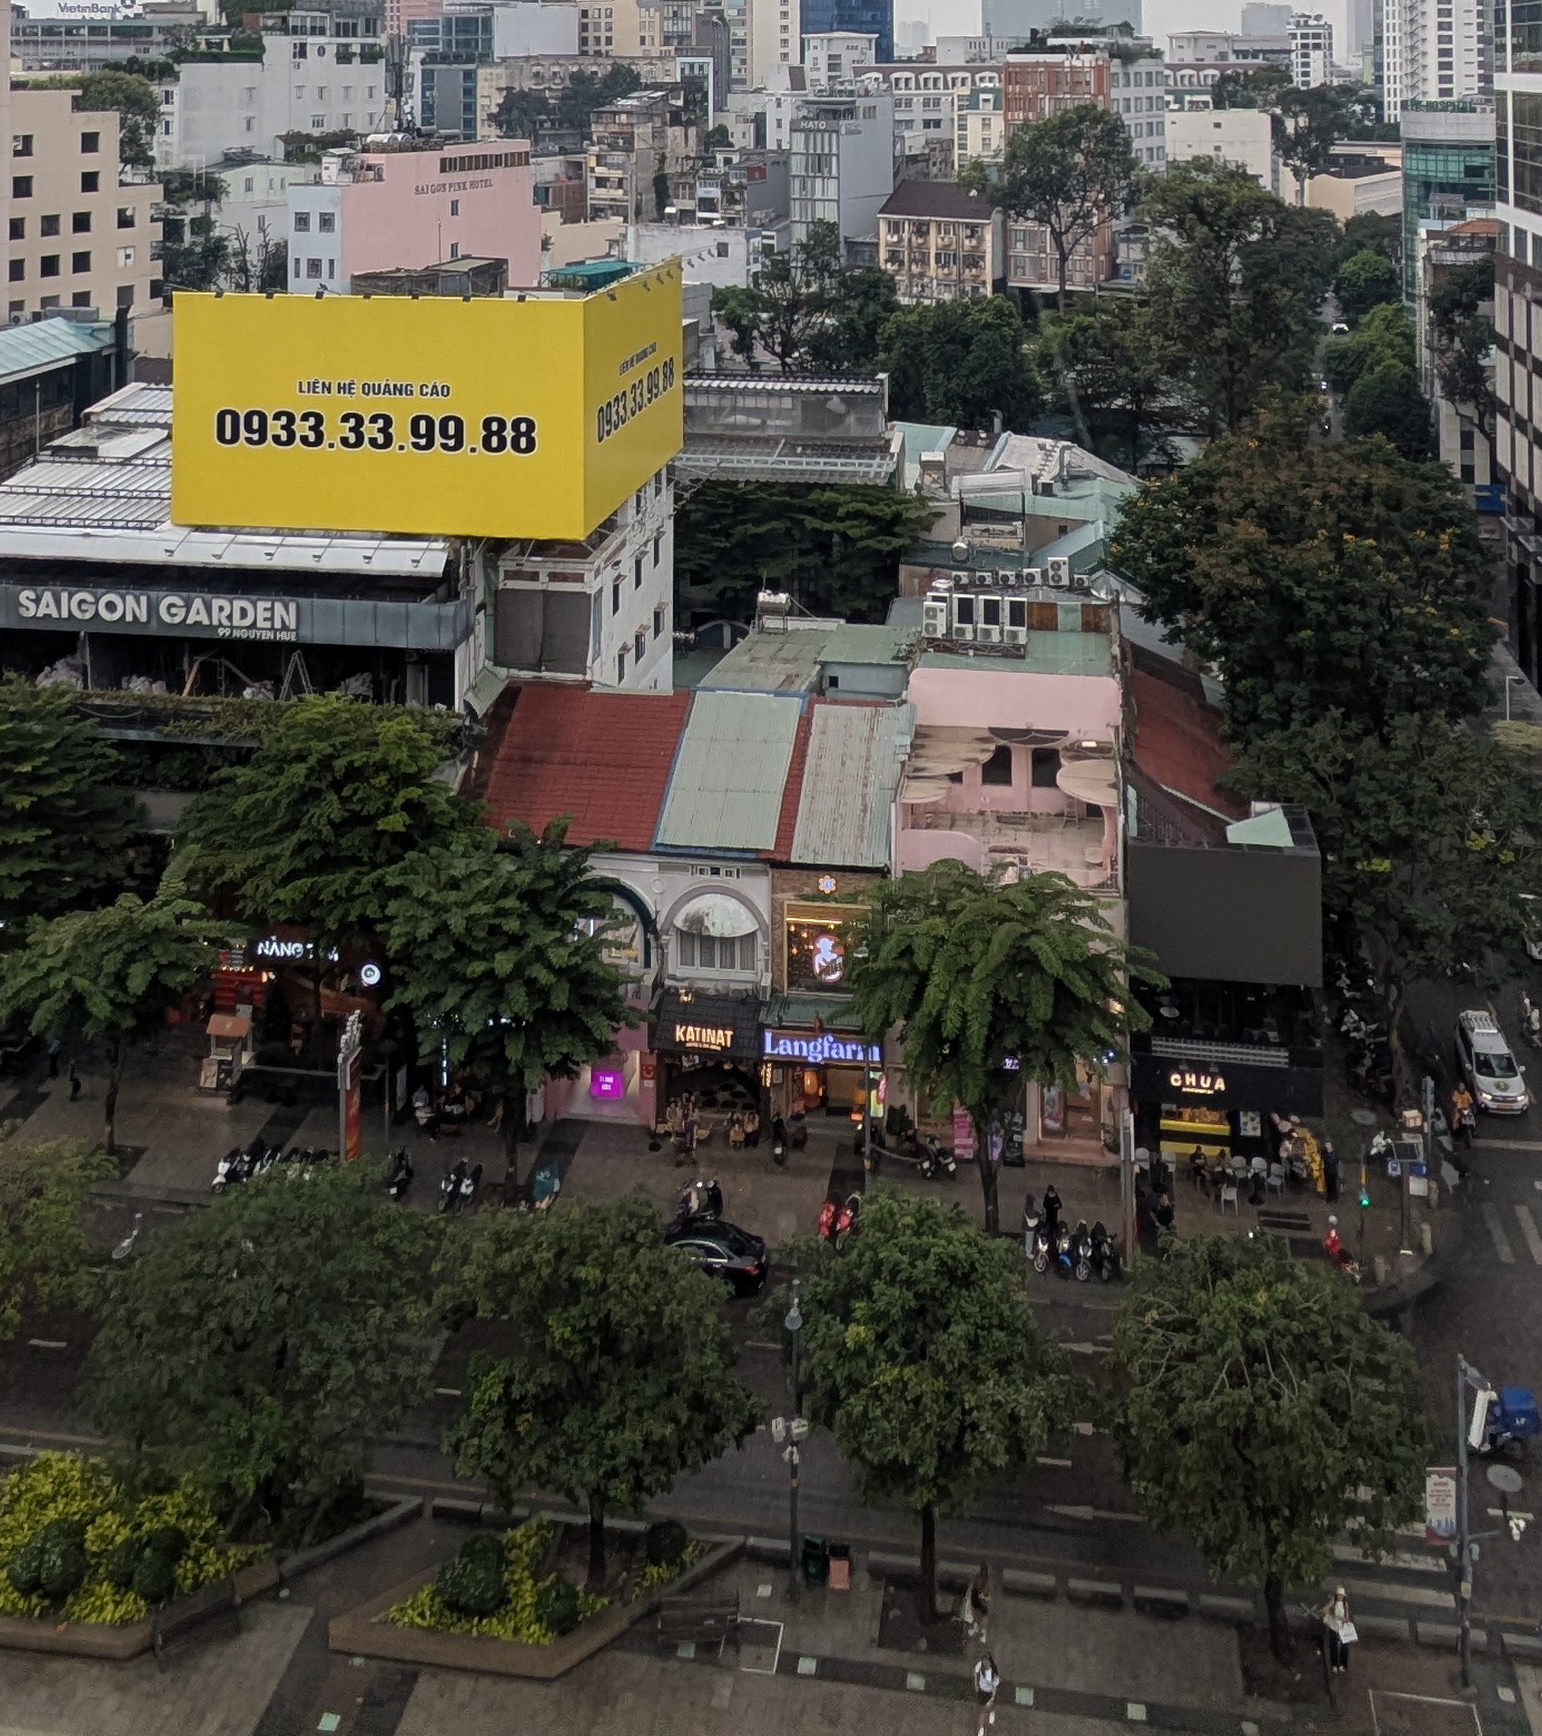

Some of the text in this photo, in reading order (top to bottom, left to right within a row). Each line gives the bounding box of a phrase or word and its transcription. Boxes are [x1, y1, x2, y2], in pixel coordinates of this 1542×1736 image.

[58, 3, 121, 14] VietinBank
[800, 121, 826, 130] HATO
[415, 183, 447, 196] SAIGON
[469, 178, 493, 190] HOTEL
[298, 378, 451, 399] LIÊN HỆ QUẢNG CÁO
[597, 356, 675, 444] 0933.33.99.88
[215, 409, 537, 455] 0933.33.99.88
[18, 590, 298, 630] SAIGON GARDEN
[217, 627, 231, 638] 99
[675, 1025, 734, 1048] KATINAT
[764, 1031, 880, 1062] Langfarm
[1170, 1072, 1226, 1093] CHUA
